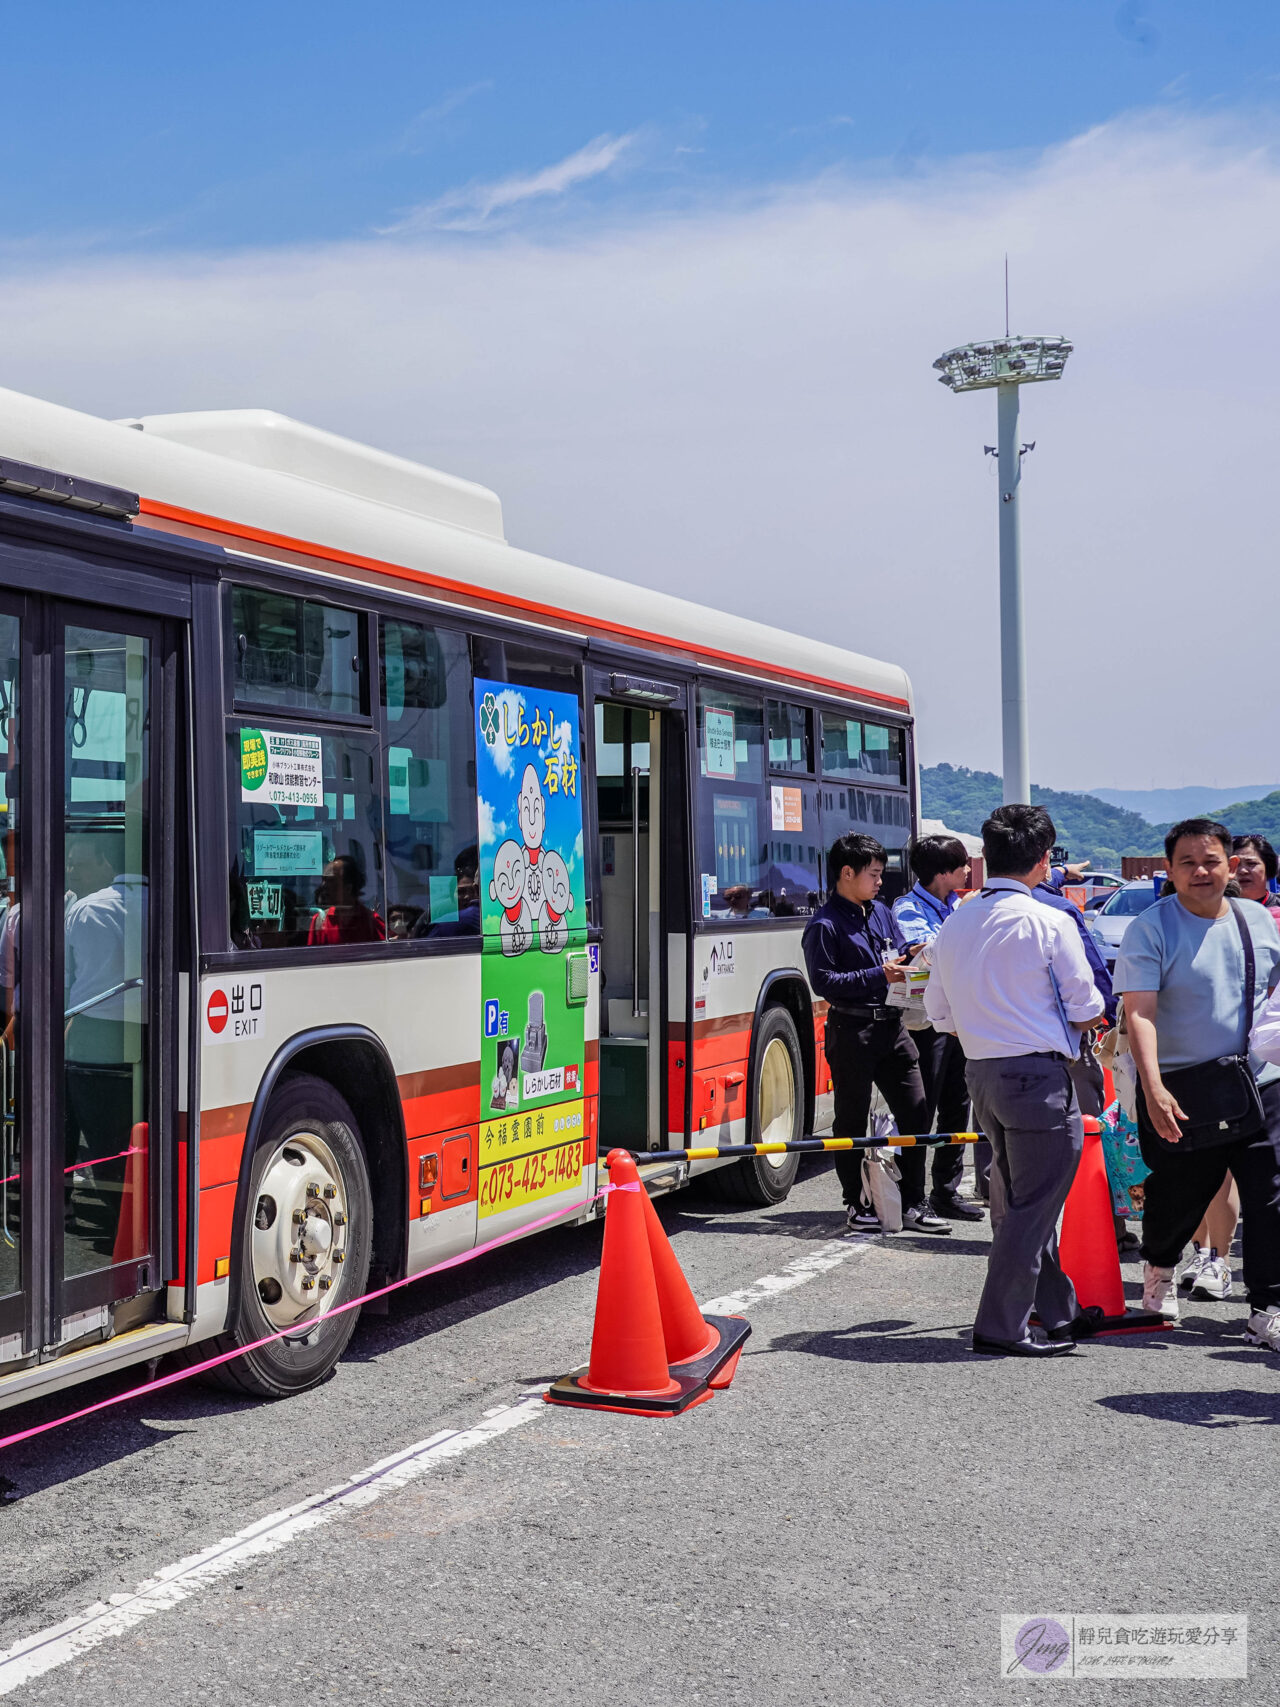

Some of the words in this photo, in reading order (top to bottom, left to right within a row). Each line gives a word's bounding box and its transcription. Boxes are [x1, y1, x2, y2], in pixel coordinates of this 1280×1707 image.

[503, 703, 562, 749] しらかし
[243, 738, 261, 752] 現場で
[242, 750, 266, 770] 即実践
[719, 755, 722, 767] 2
[268, 772, 284, 785] 和歌山
[544, 753, 578, 797] 石材
[273, 790, 318, 804] 073-413-0956
[249, 886, 280, 915] 貸切
[719, 942, 733, 961] 入口
[717, 963, 735, 975] ENTRANCE
[231, 984, 262, 1014] 出口
[234, 1018, 258, 1037] EXIT
[525, 1073, 562, 1095] しらかし石材
[565, 1070, 578, 1085] 検索
[484, 1113, 545, 1149] 今福霊園前
[488, 1143, 582, 1205] 073-425-1483
